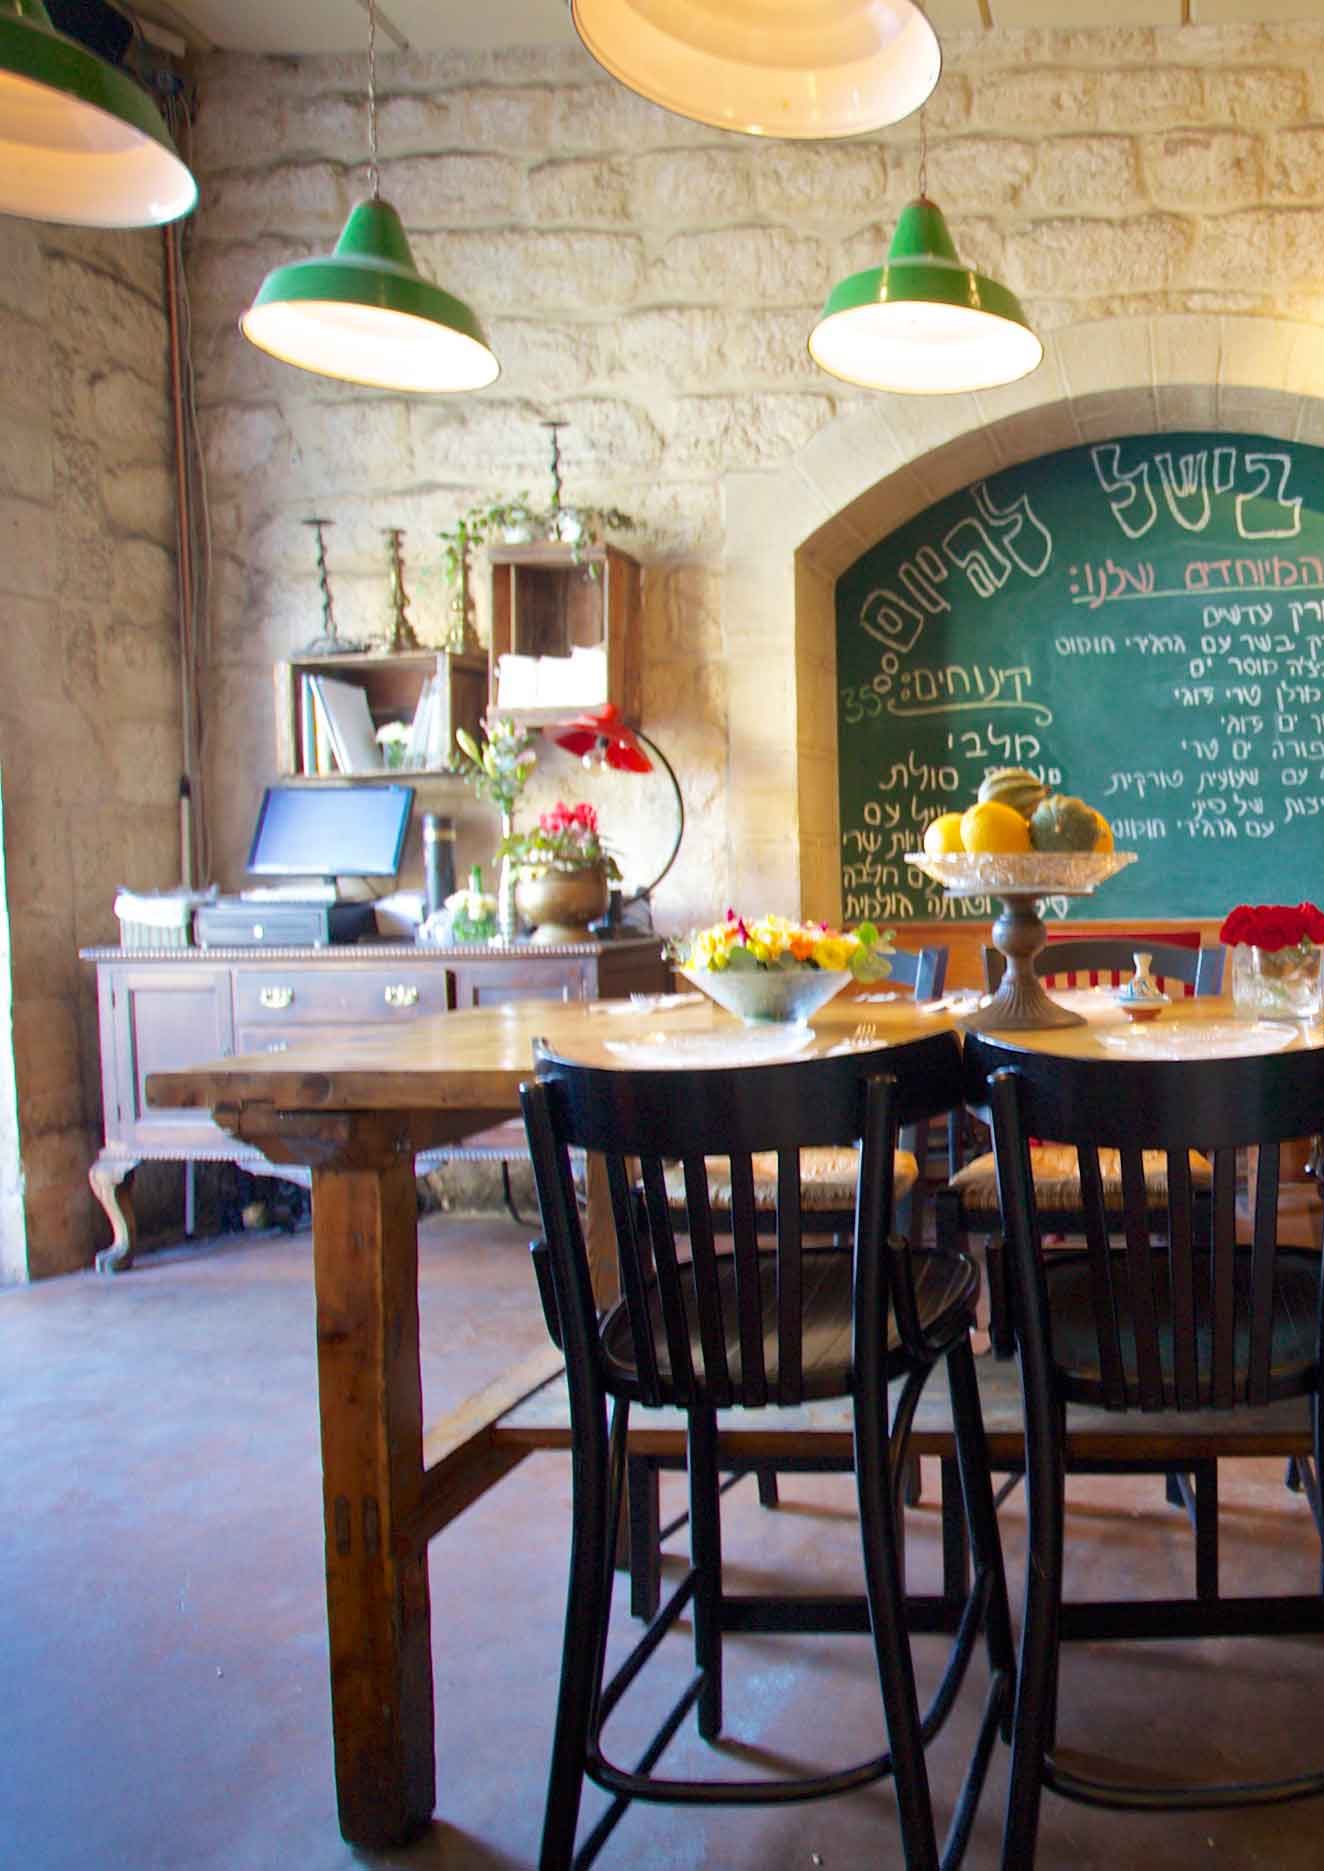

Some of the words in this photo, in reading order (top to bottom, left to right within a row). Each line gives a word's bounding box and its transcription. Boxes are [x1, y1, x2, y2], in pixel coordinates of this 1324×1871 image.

[1185, 556, 1324, 589] המיוחדים
[1203, 603, 1273, 628] עדשים
[1201, 634, 1232, 655] עם
[1240, 634, 1296, 653] בשר
[1189, 658, 1214, 679] ים
[1278, 714, 1299, 734] ים
[948, 723, 1041, 762] מלבי
[1232, 738, 1252, 760] ים
[879, 751, 960, 791] סולת
[1281, 767, 1309, 787] עם
[863, 800, 901, 829] עם
[1233, 793, 1265, 818] של
[1244, 819, 1276, 839] עם
